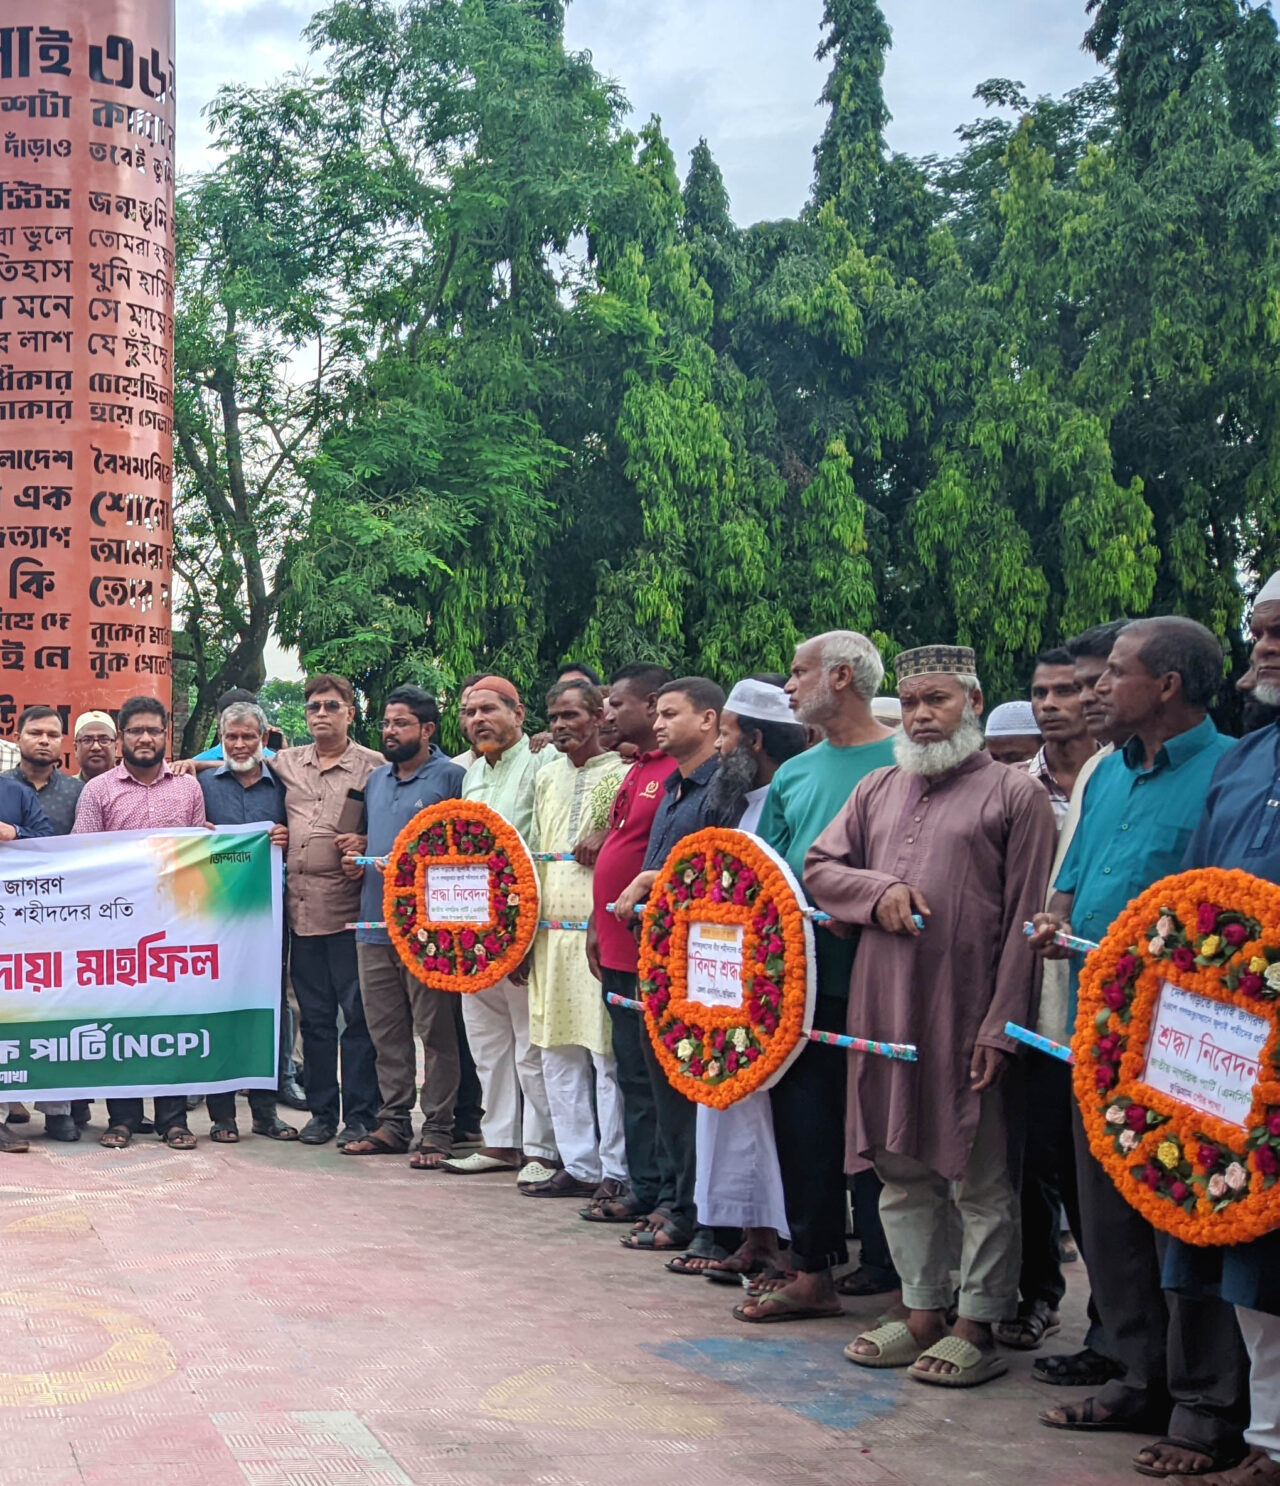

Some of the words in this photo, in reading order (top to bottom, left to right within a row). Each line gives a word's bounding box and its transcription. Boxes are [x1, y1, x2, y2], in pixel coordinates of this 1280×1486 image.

[89, 34, 167, 103] ৩৬
[5, 131, 73, 163] দাঁড়াও
[89, 142, 146, 175] তবেই
[21, 225, 74, 251] ভুলে
[89, 229, 150, 257] তোমরা
[89, 256, 133, 293] খুনি
[13, 295, 74, 319] মনে
[89, 298, 121, 323] সে
[17, 331, 74, 353] লাশ
[88, 333, 118, 358] যে
[89, 402, 134, 429] হয়ে
[14, 485, 73, 510] এক
[89, 538, 163, 569] আমরা
[9, 557, 56, 600] কি
[41, 612, 72, 631] দে
[89, 622, 146, 648] বুকের
[34, 646, 72, 670] নে
[89, 651, 131, 679] বুক
[209, 850, 252, 865] জিন্দাবাদ
[4, 876, 65, 897] জাগরণ
[453, 883, 489, 902] নিবেদন
[13, 899, 92, 925] শহীদদের
[98, 896, 135, 921] প্রতি
[76, 930, 220, 987] মাহফিল
[1157, 1023, 1194, 1060] শ্রদ্ধা
[1196, 1031, 1263, 1083] নিবেদন
